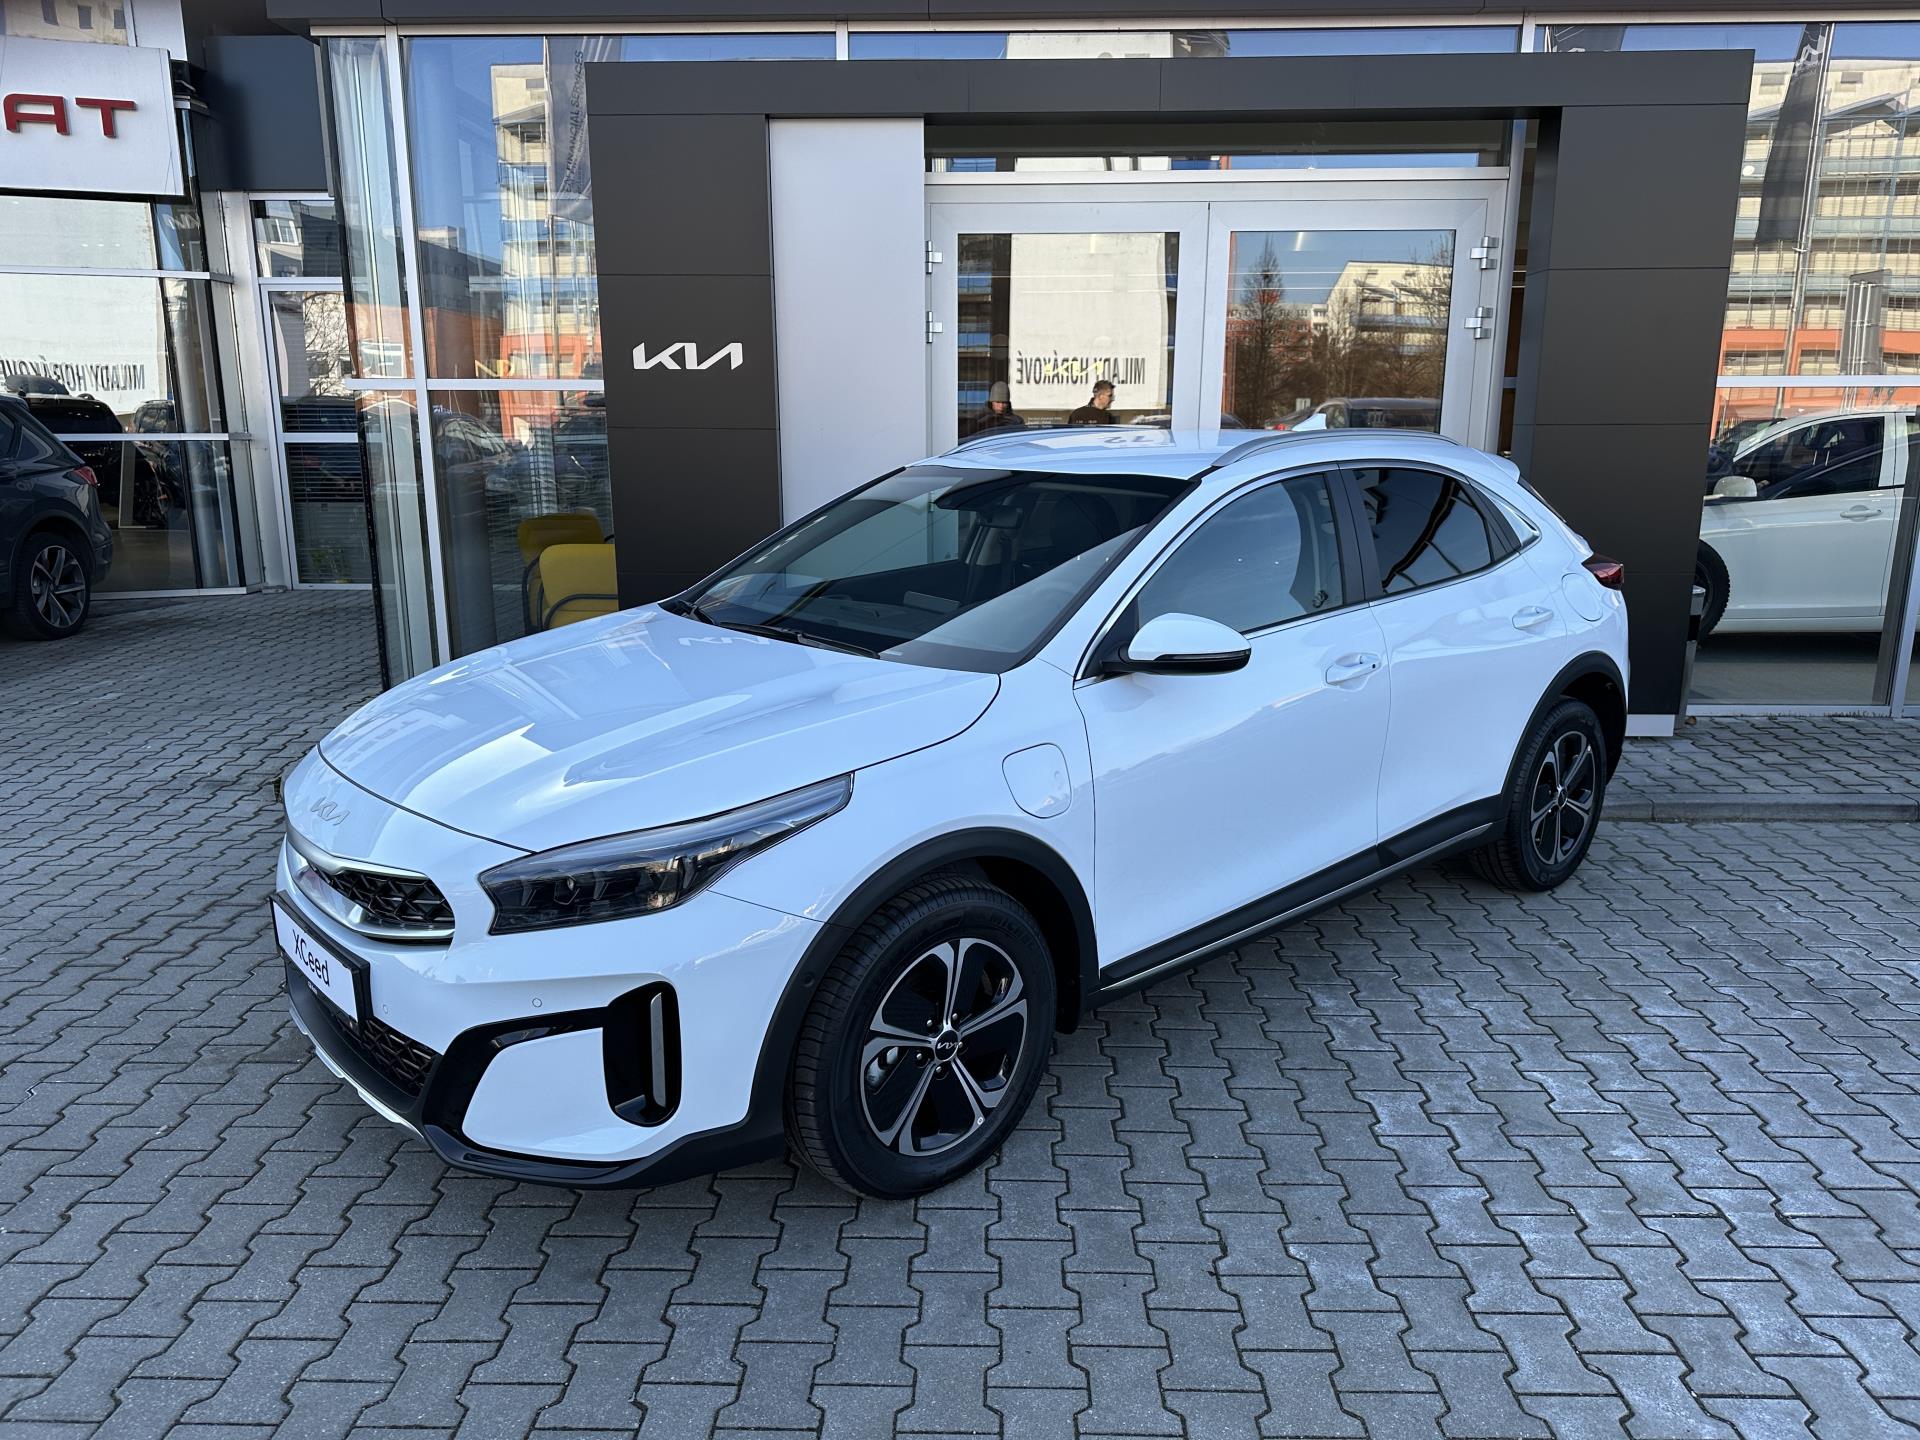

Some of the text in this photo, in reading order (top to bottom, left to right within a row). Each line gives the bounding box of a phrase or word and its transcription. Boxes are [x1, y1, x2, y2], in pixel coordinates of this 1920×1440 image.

[570, 49, 584, 107] SERVICES
[632, 342, 743, 370] KIA
[310, 796, 350, 826] KIA
[292, 929, 329, 986] XCeed
